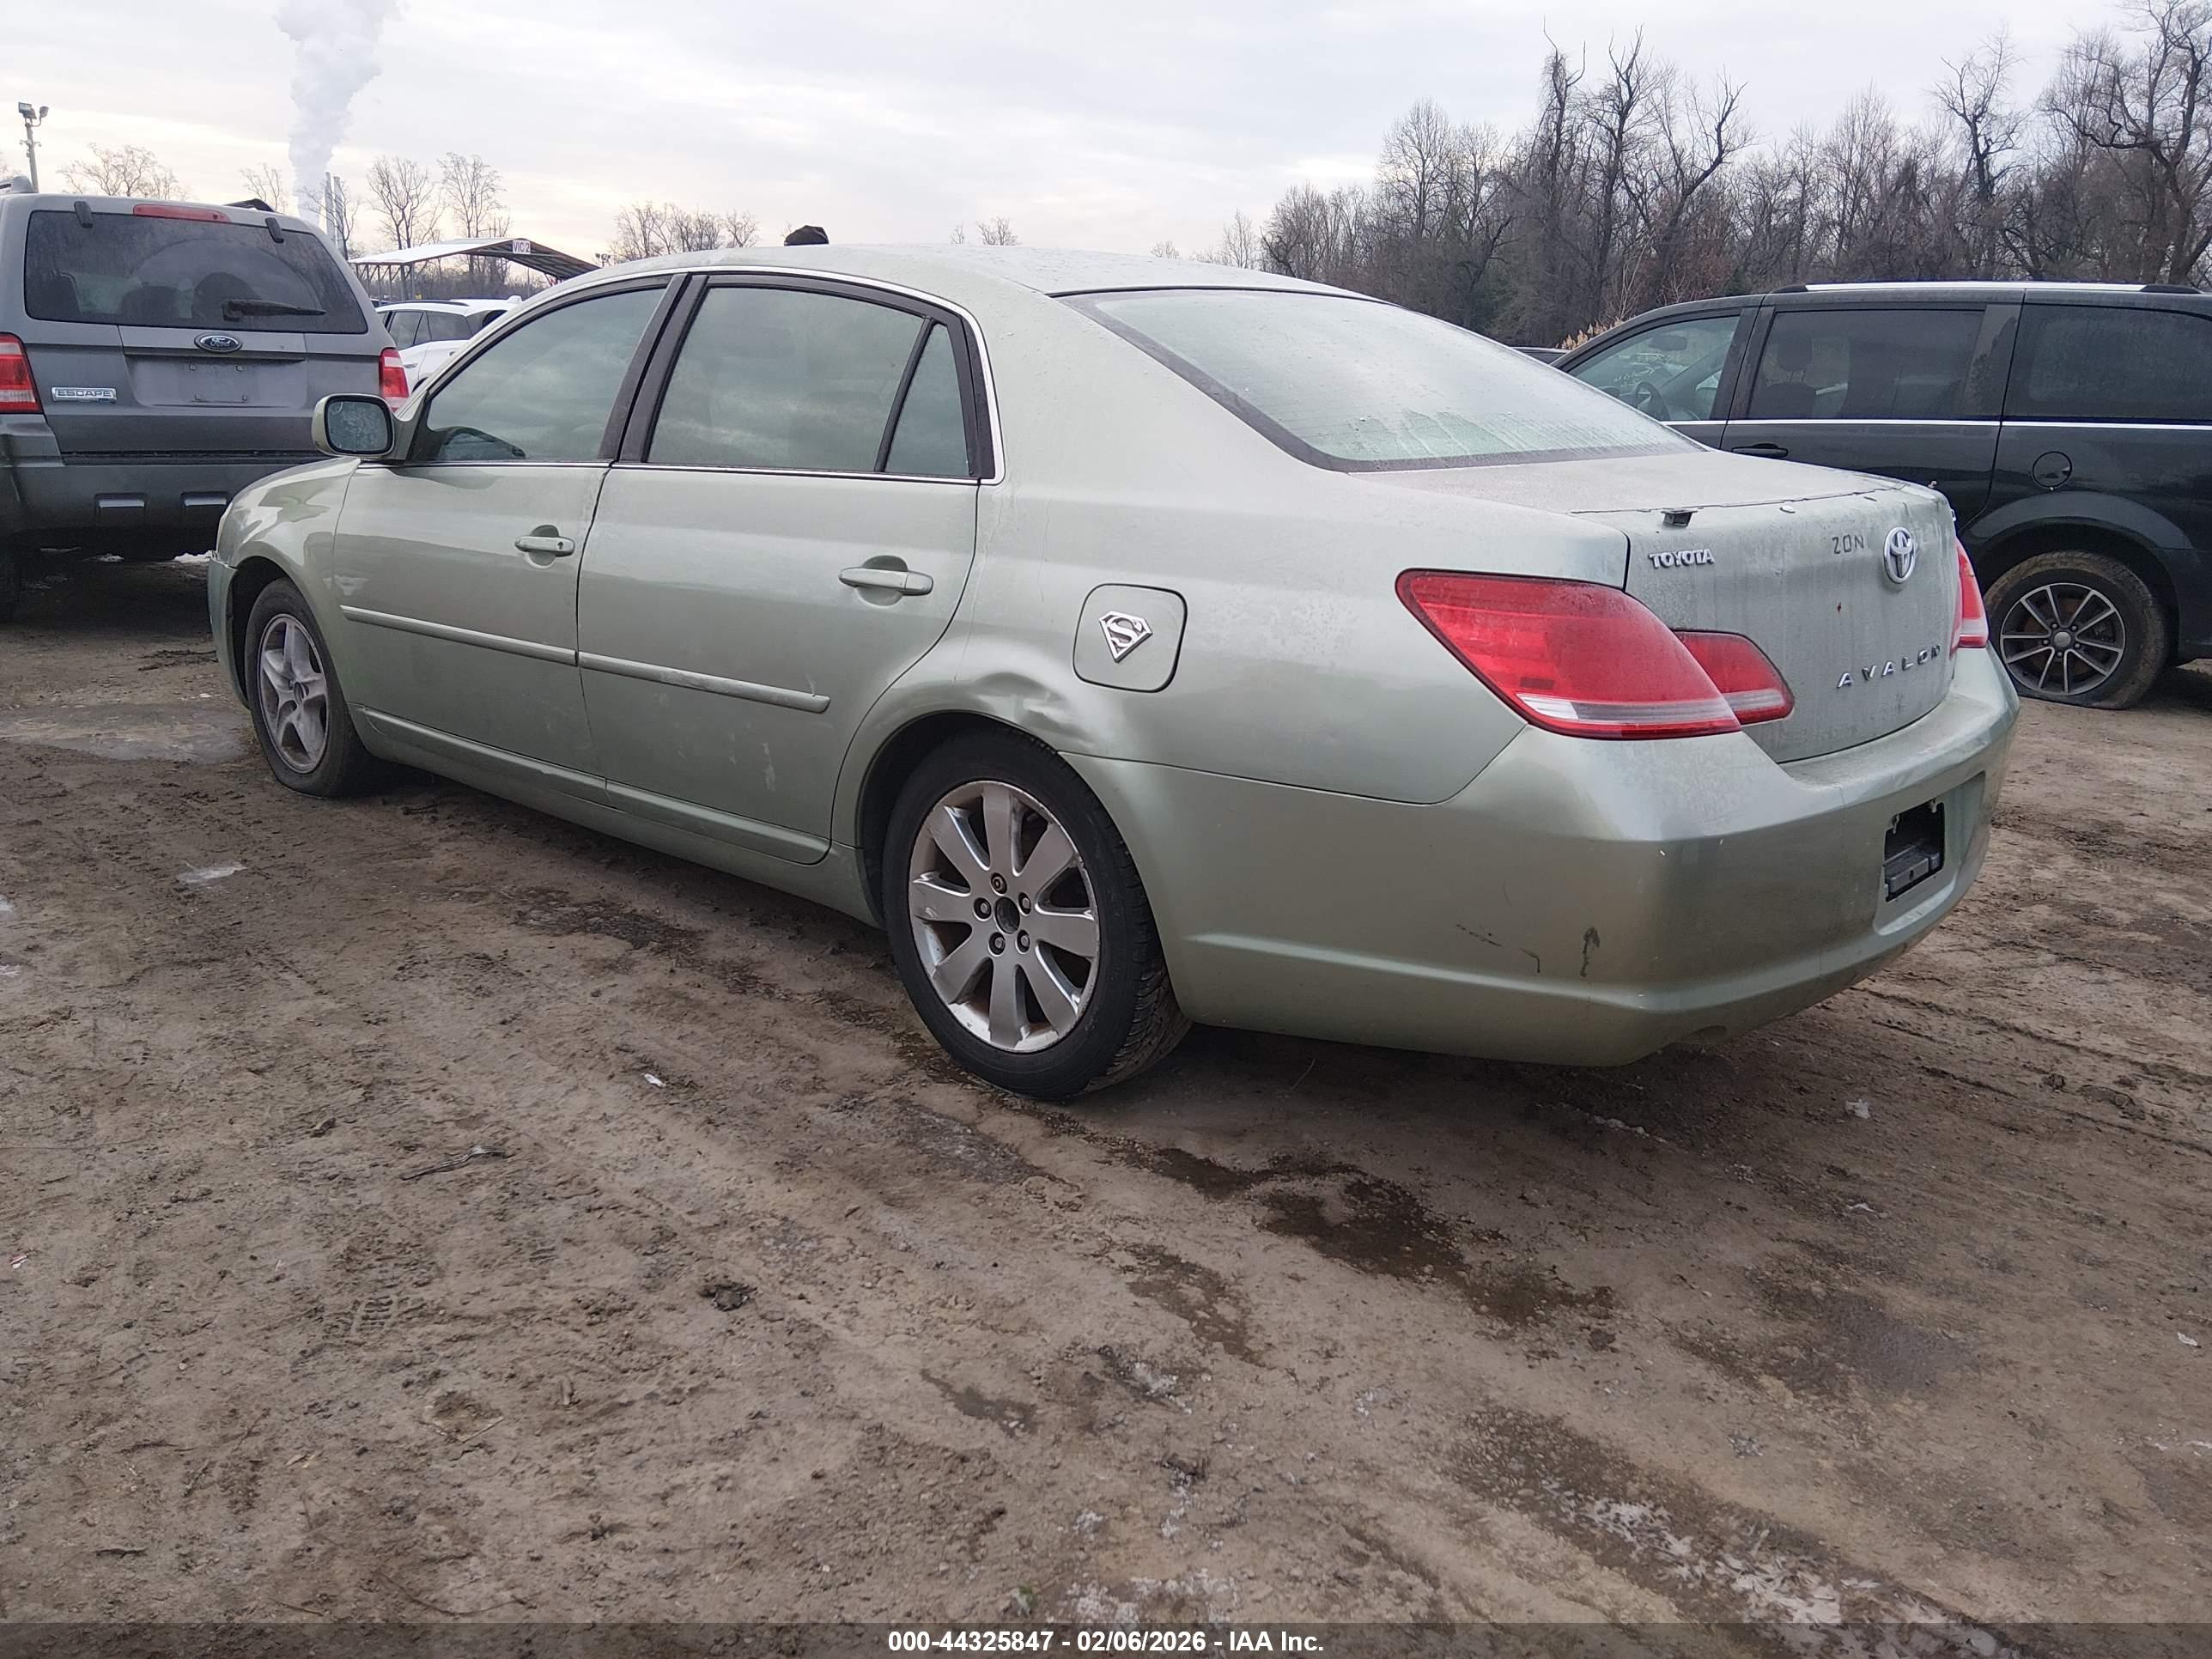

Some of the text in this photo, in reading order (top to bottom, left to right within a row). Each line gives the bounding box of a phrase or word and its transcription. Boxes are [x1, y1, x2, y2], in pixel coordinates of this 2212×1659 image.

[513, 241, 524, 252] VIC
[1648, 549, 1716, 569] TOYOTA
[1837, 645, 1941, 689] AVALON
